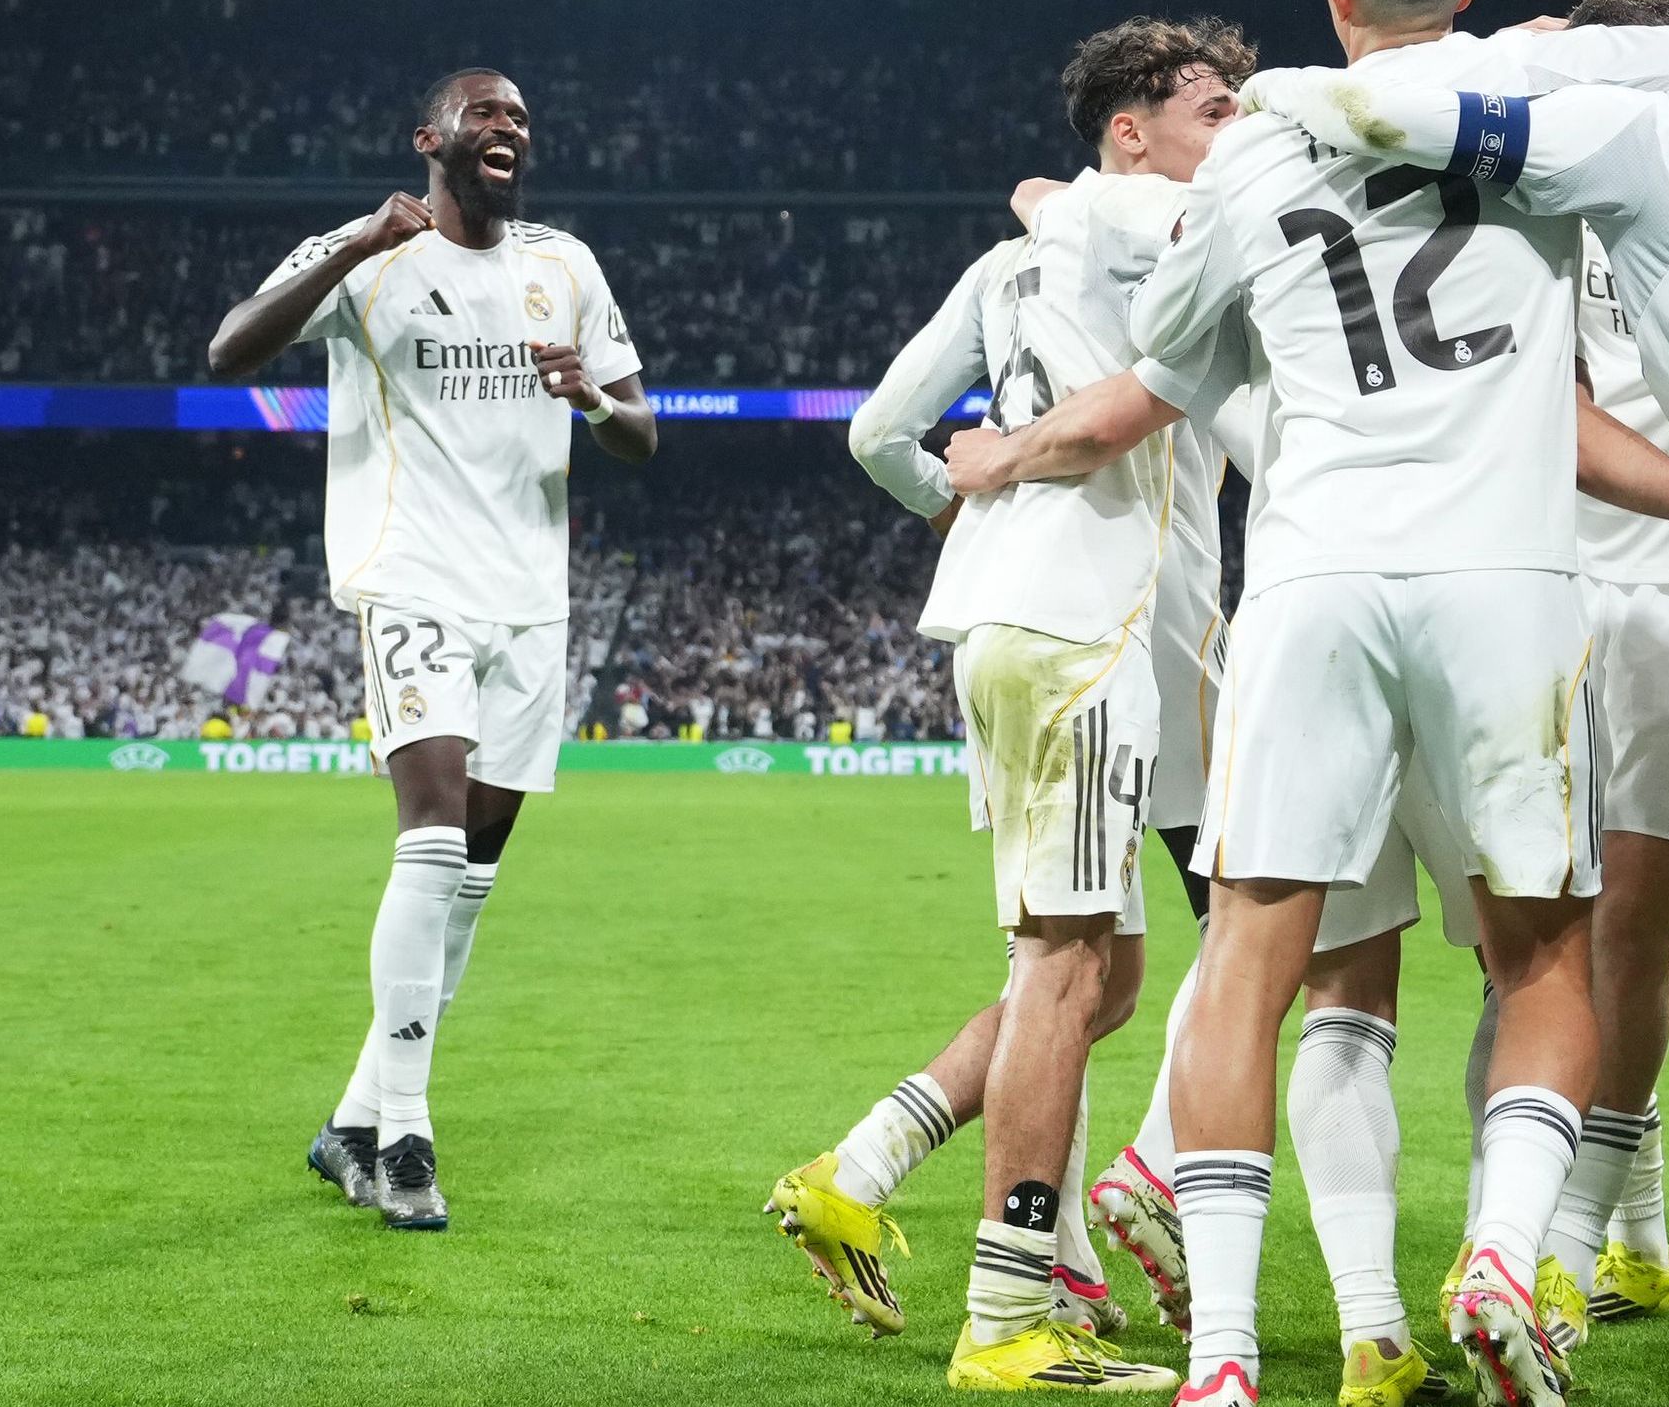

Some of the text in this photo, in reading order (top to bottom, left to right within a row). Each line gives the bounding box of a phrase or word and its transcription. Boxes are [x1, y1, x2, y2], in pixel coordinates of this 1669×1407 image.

[1277, 162, 1518, 397] 12
[439, 373, 537, 401] FLY BETTER
[663, 394, 740, 415] LEAGUE
[381, 621, 449, 681] 22
[198, 743, 367, 773] TOGETH
[803, 746, 966, 776] TOGETH
